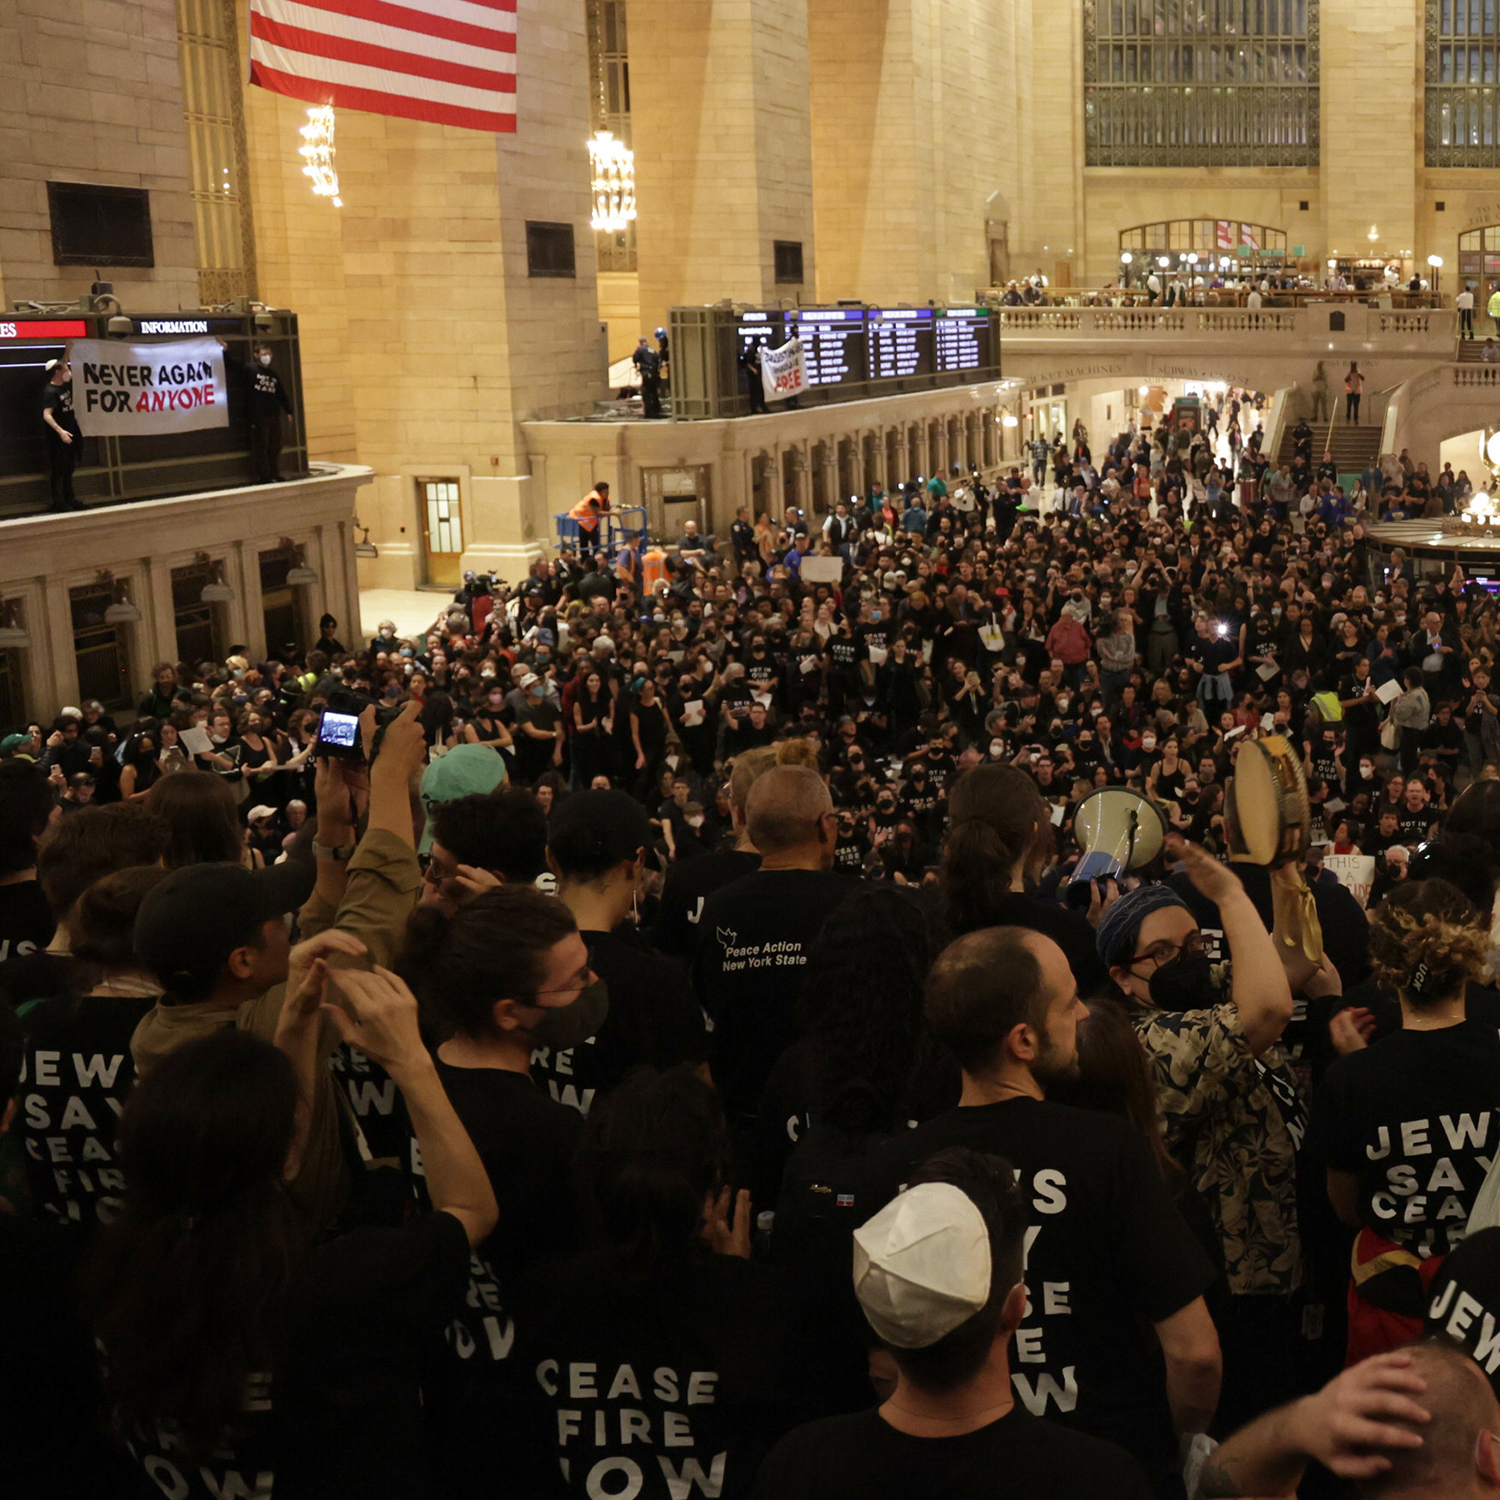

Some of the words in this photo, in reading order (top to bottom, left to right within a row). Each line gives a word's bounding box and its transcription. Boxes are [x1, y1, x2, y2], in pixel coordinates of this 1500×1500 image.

[141, 321, 208, 334] INFORMATION
[83, 362, 152, 387] NEVER
[157, 360, 213, 385] AGAIN
[86, 389, 133, 413] FOR
[135, 384, 215, 413] ANYONE
[1324, 857, 1360, 869] THIS
[722, 959, 746, 973] New
[748, 956, 772, 969] York
[775, 953, 808, 967] State
[725, 945, 760, 958] Peace
[763, 940, 802, 954] Action
[1412, 962, 1429, 993] UCK
[1365, 1111, 1492, 1161] JEW
[51, 1167, 128, 1194] FIR
[1371, 1190, 1468, 1224] CEA
[535, 1358, 720, 1406] CEASE
[556, 1408, 695, 1447] FIRE
